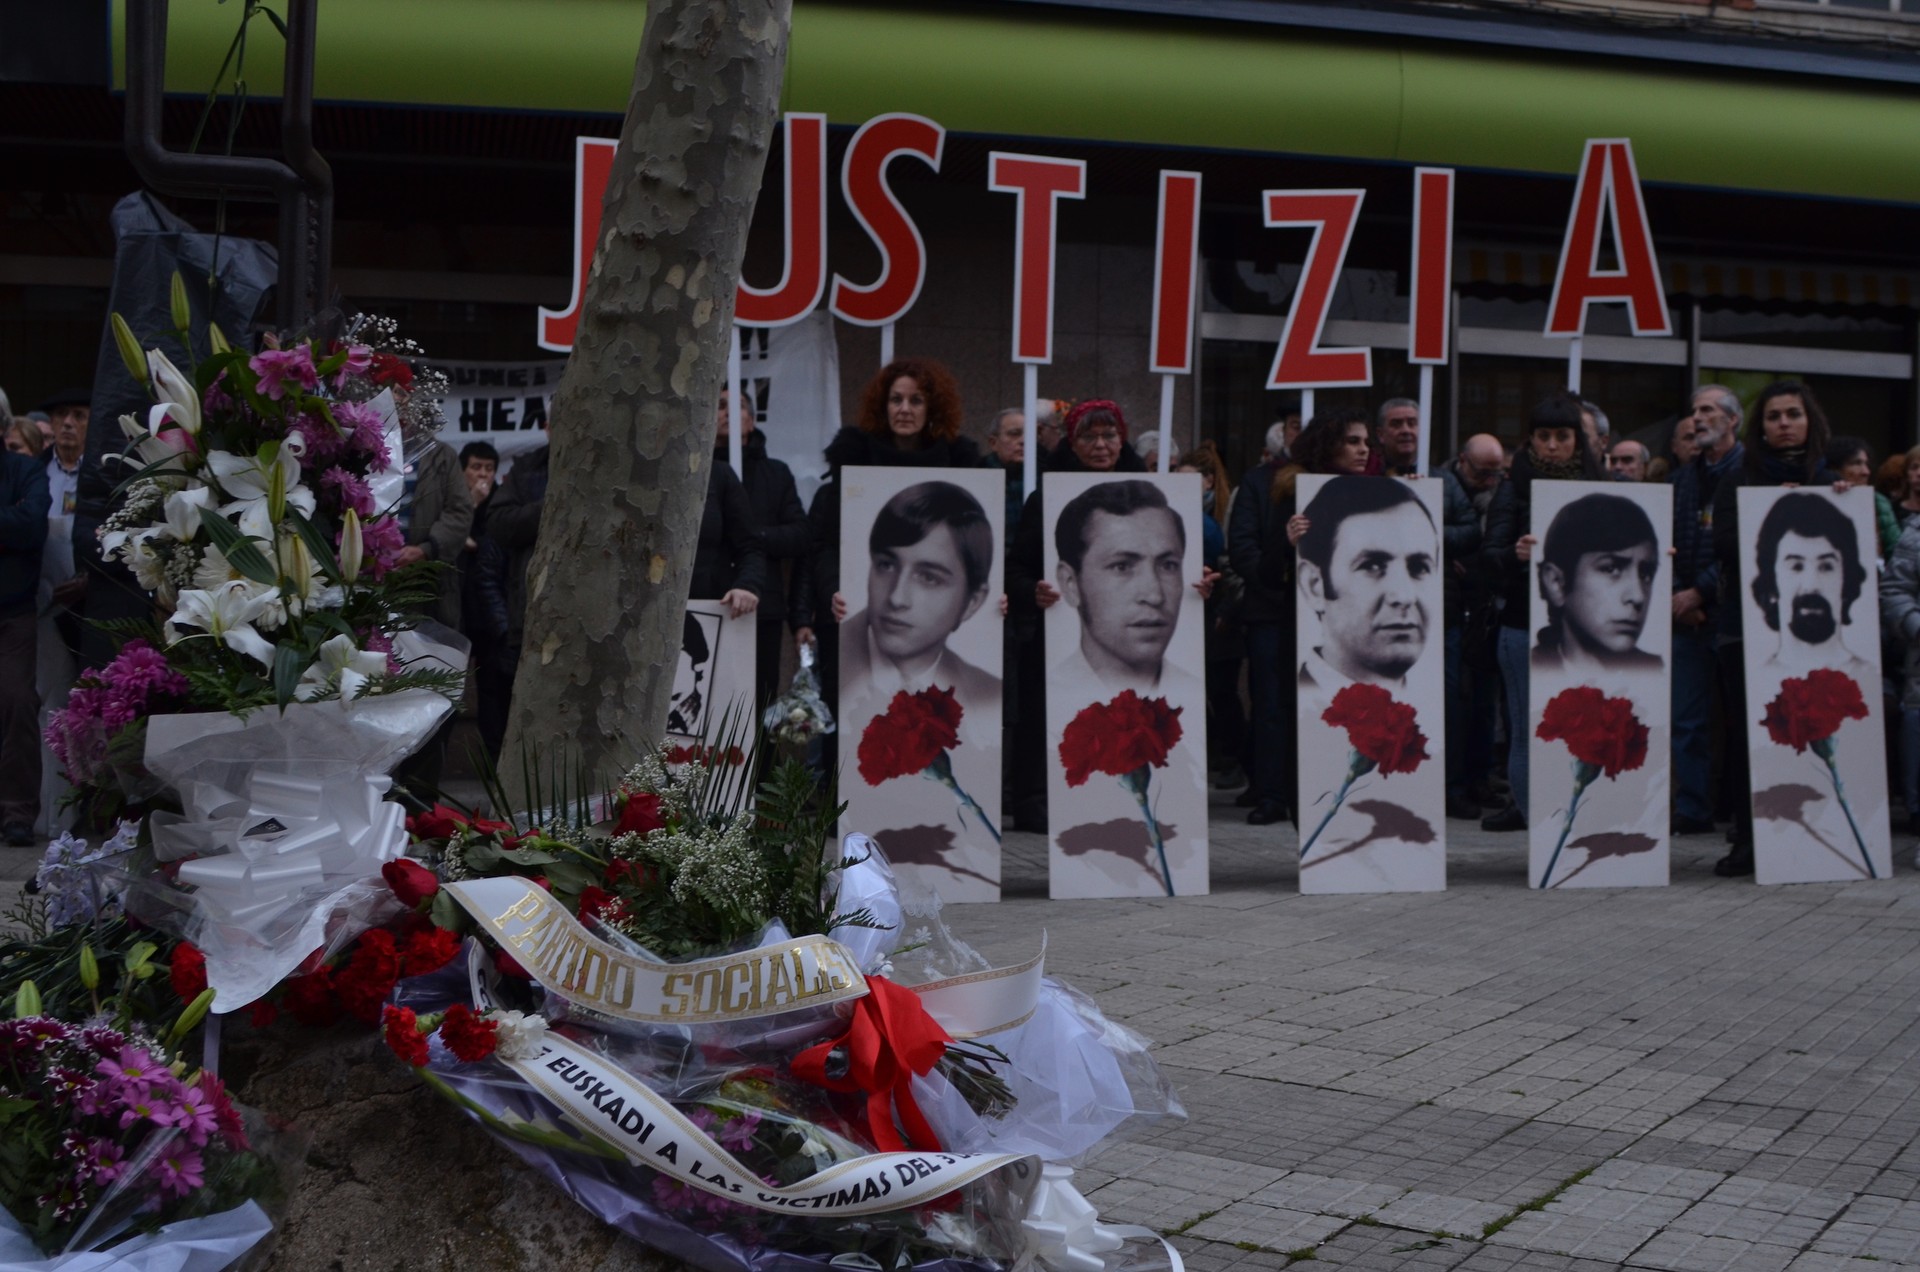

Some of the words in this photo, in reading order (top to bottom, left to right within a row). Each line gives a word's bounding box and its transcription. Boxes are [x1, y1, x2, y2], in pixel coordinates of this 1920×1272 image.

[492, 891, 635, 1010] PARTIDO
[546, 1057, 656, 1144] EUSKADI
[656, 1141, 679, 1165] A
[689, 1160, 743, 1193] LAS
[757, 1170, 892, 1209] VICTIMAS
[894, 1157, 942, 1188] DEL
